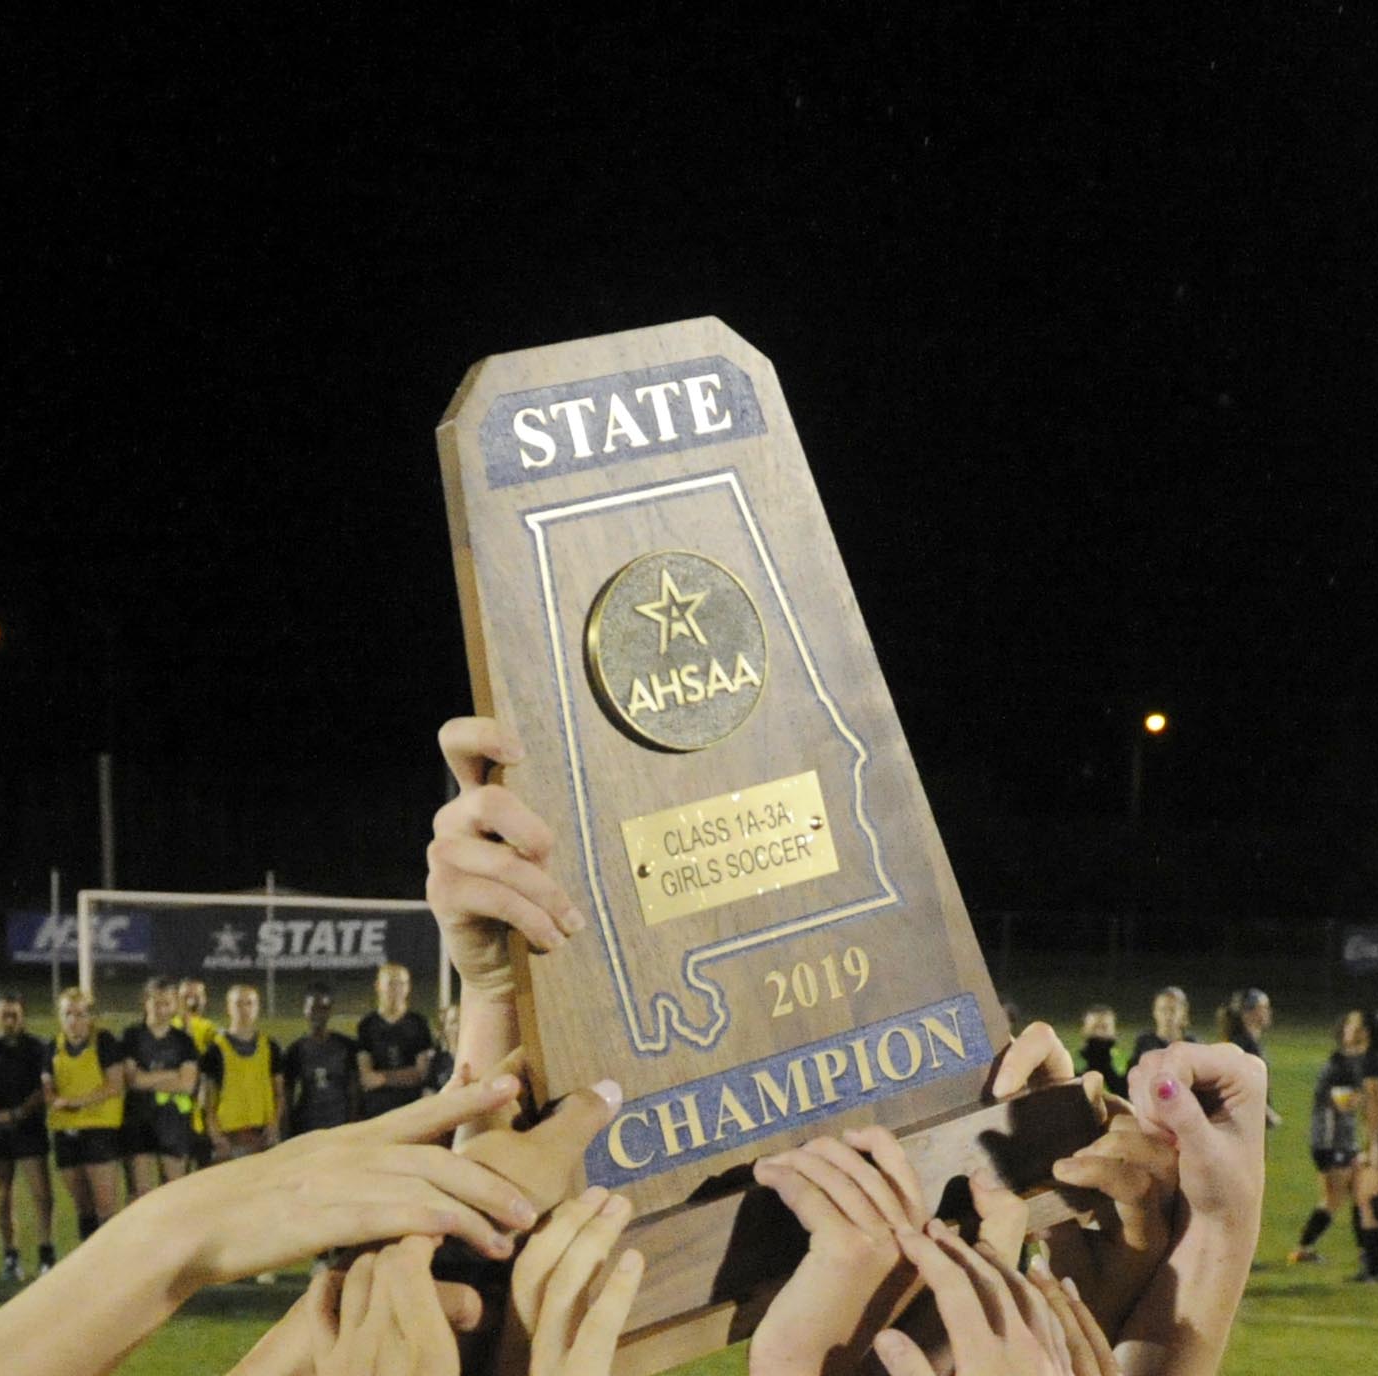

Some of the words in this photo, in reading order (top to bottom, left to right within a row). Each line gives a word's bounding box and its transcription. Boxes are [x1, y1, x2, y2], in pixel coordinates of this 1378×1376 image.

[513, 373, 732, 469] STATE
[627, 652, 761, 717] AHSAA
[663, 817, 731, 857] CLASS
[736, 801, 791, 837] 1A-3A
[661, 858, 722, 897] GIRLS
[725, 834, 811, 878] SOCCER
[255, 920, 388, 953] STATE
[764, 946, 870, 1019] 2019
[606, 1006, 968, 1170] CHAMPION
